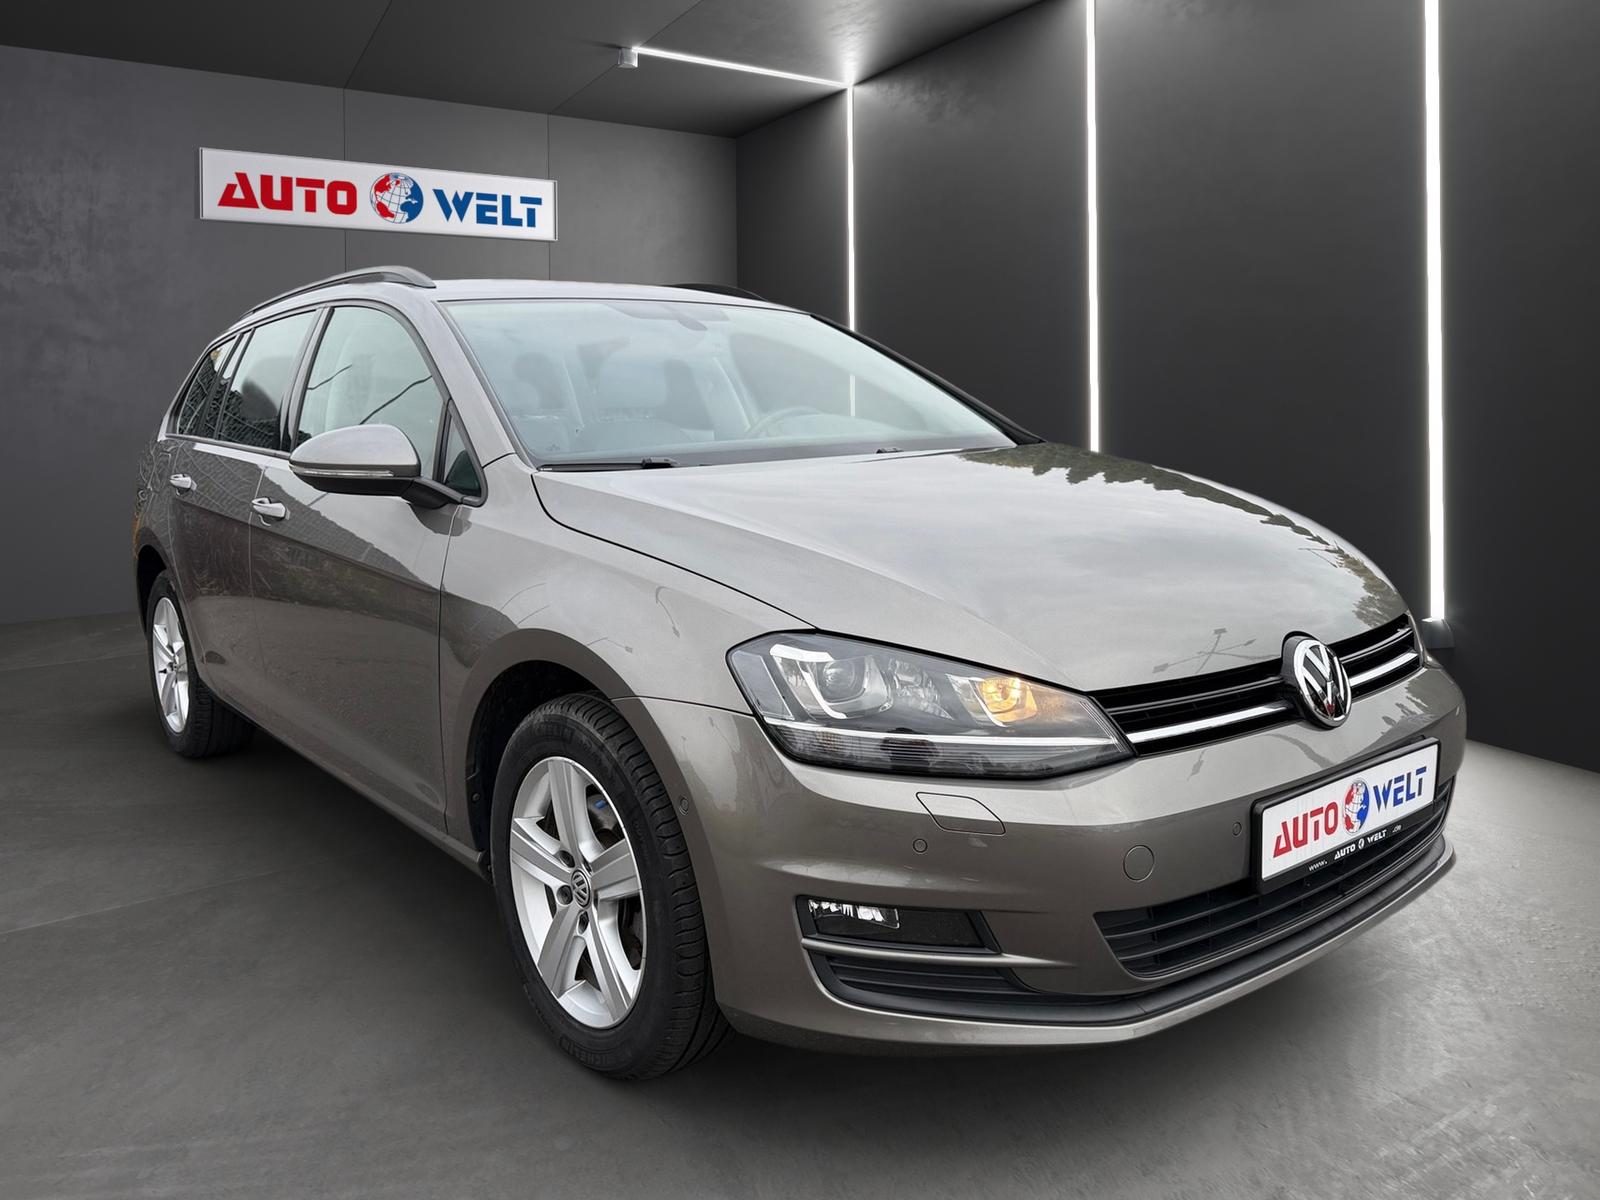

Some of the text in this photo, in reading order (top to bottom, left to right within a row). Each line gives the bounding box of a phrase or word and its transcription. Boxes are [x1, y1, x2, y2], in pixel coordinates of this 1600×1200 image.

[217, 171, 543, 228] AUTO WELT
[1273, 766, 1428, 859] AUTO WELT
[1334, 844, 1356, 860] AUTO
[1367, 829, 1387, 844] WELT
